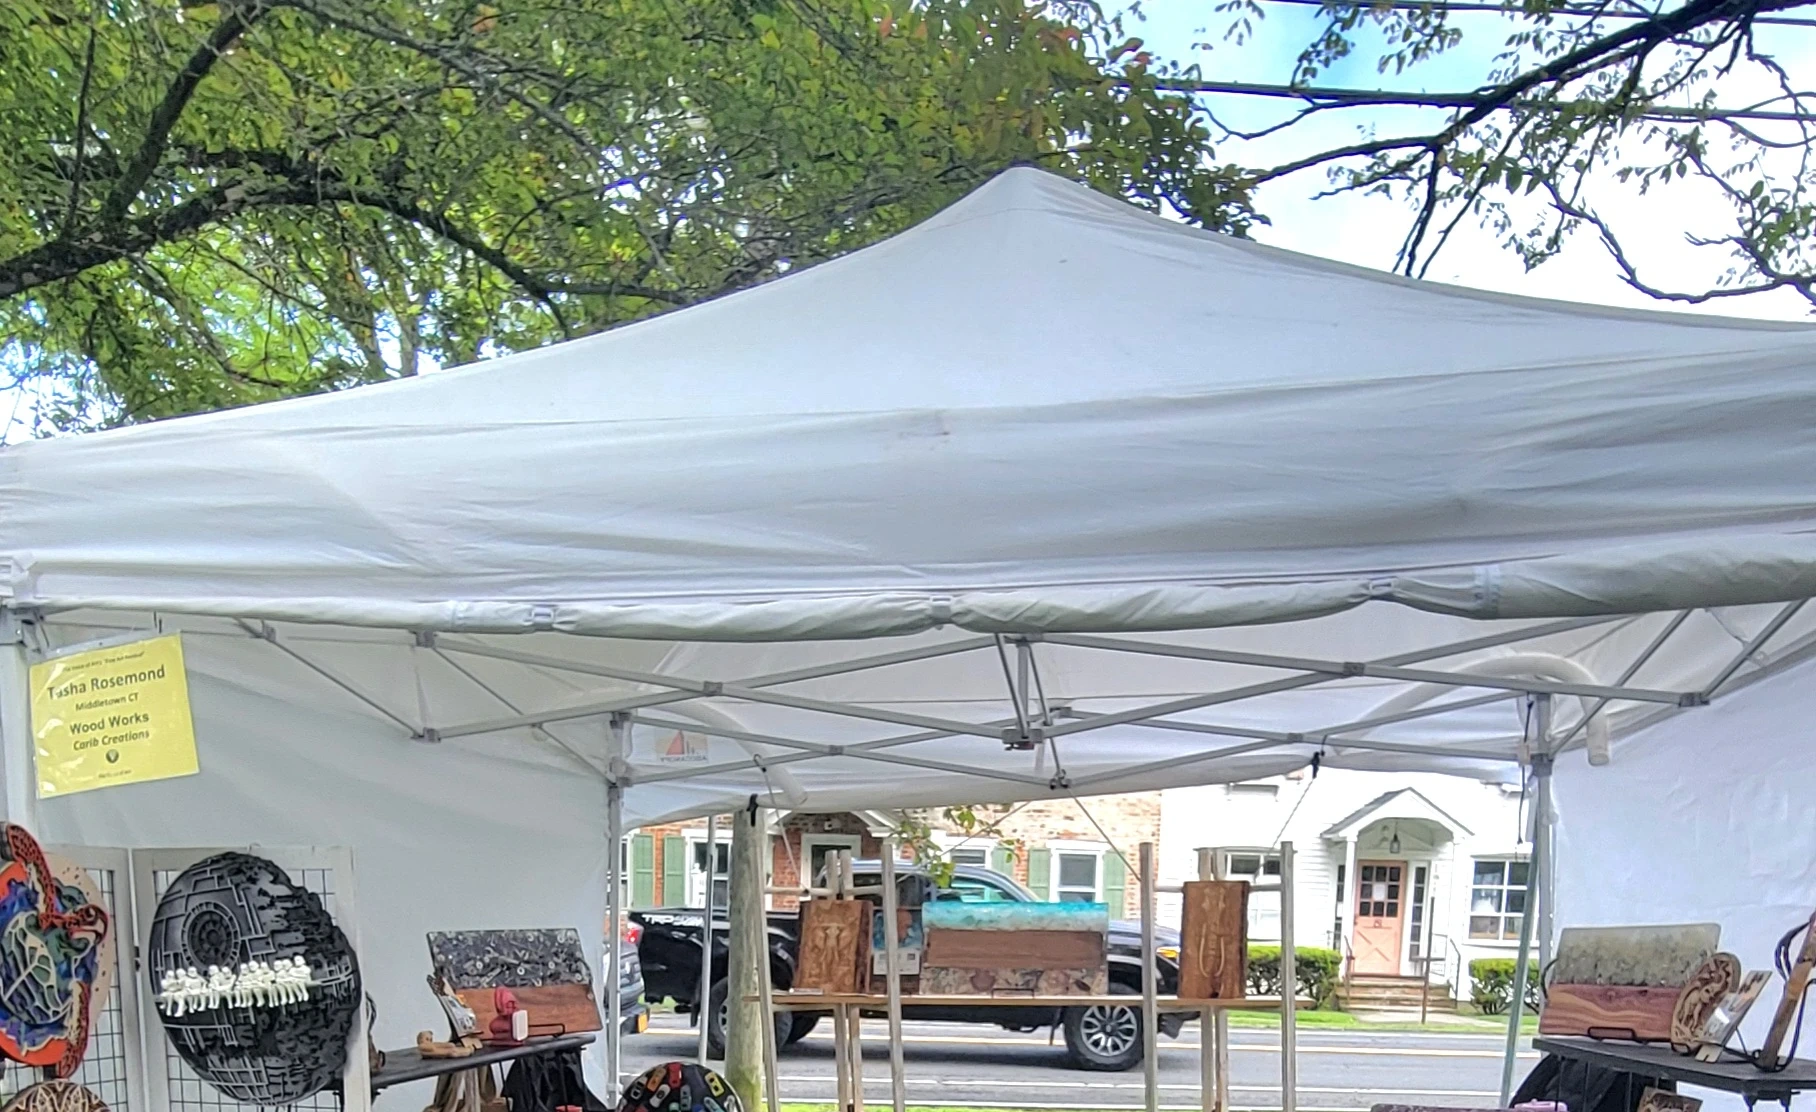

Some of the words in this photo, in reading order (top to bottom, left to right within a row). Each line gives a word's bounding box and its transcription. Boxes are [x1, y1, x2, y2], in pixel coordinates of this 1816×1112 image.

[47, 682, 86, 700] Tasha
[91, 664, 166, 692] Rosemond
[75, 696, 126, 712] Middletown
[128, 692, 139, 702] CT
[69, 719, 105, 735] Wood
[109, 712, 149, 728] Works
[73, 737, 99, 751] Carib
[101, 729, 150, 746] Creations
